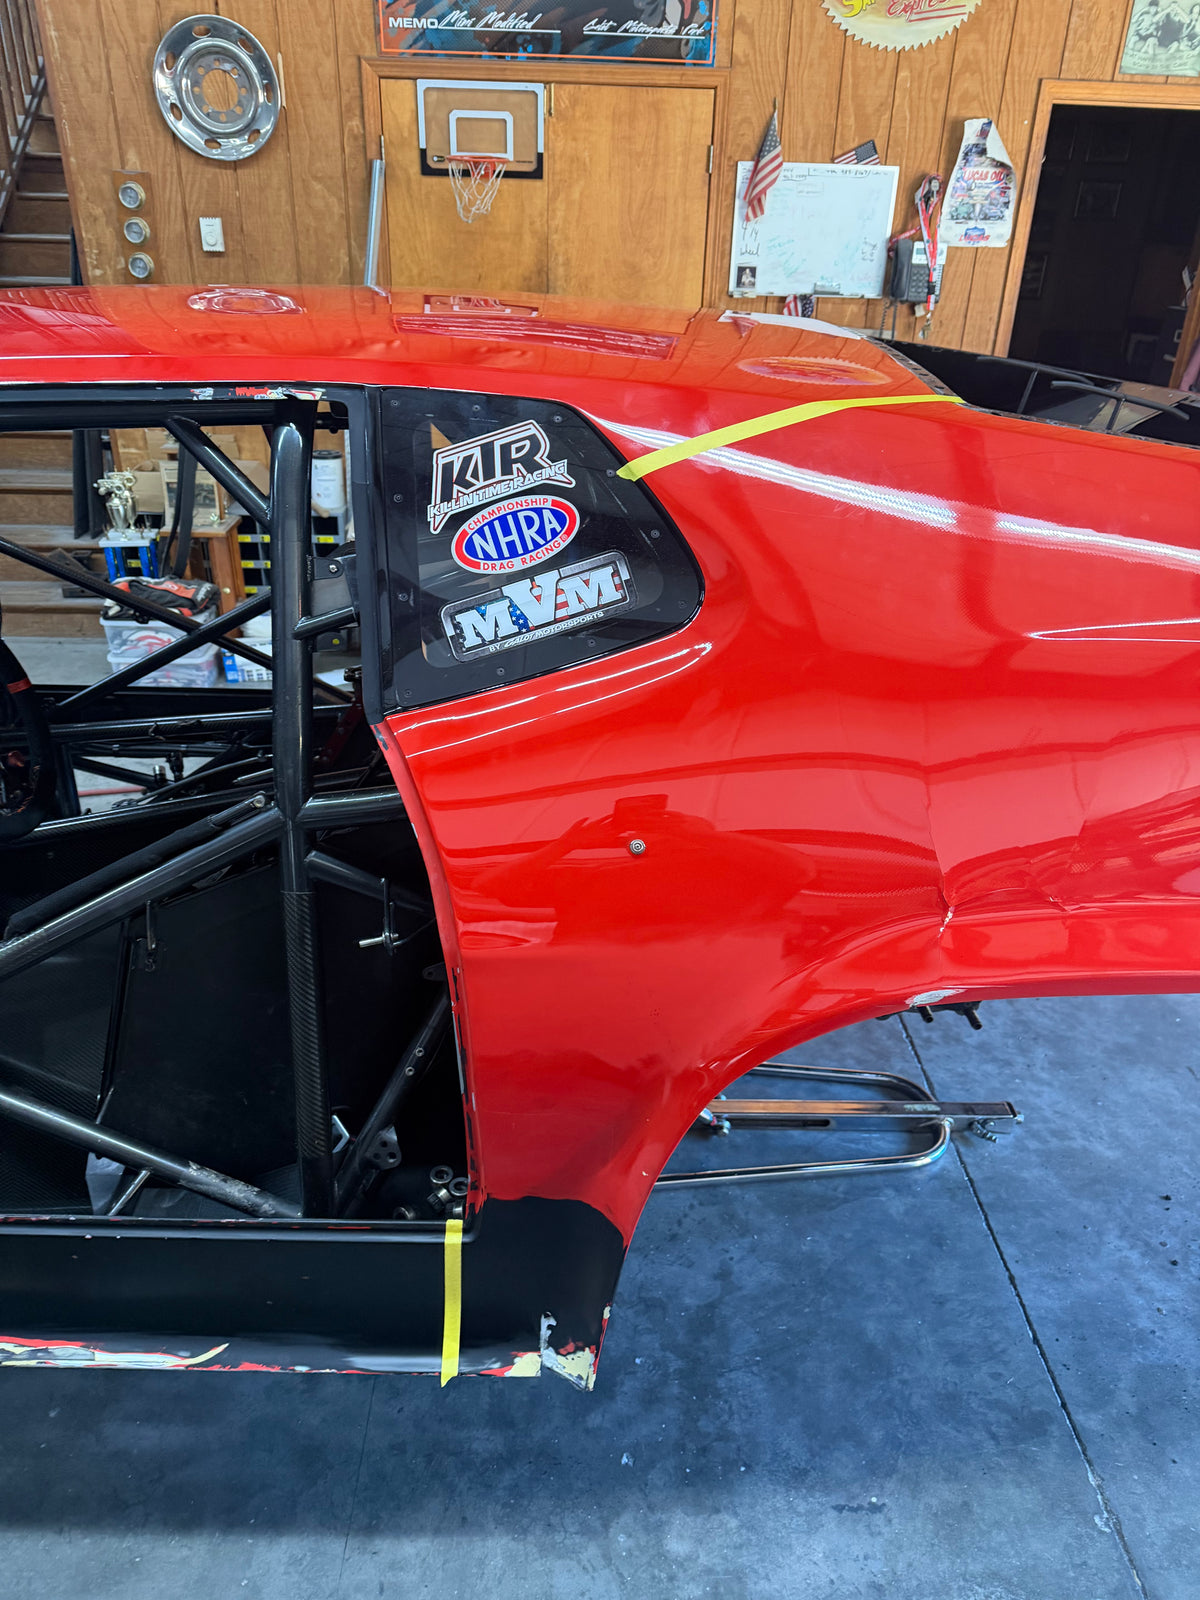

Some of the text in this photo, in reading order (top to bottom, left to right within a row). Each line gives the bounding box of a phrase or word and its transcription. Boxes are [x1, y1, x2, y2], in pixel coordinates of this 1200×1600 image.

[388, 17, 439, 29] MEMO
[475, 11, 543, 30] Modified
[430, 462, 566, 518] KILLIN TIME RACING
[438, 430, 546, 504] KTR
[467, 498, 549, 531] CHAMPIONSHIP
[471, 509, 562, 560] NHRA
[482, 540, 562, 571] DRAG RACING
[455, 570, 624, 649] MVM
[489, 644, 501, 653] BY
[535, 611, 604, 639] MOTORSPORTS
